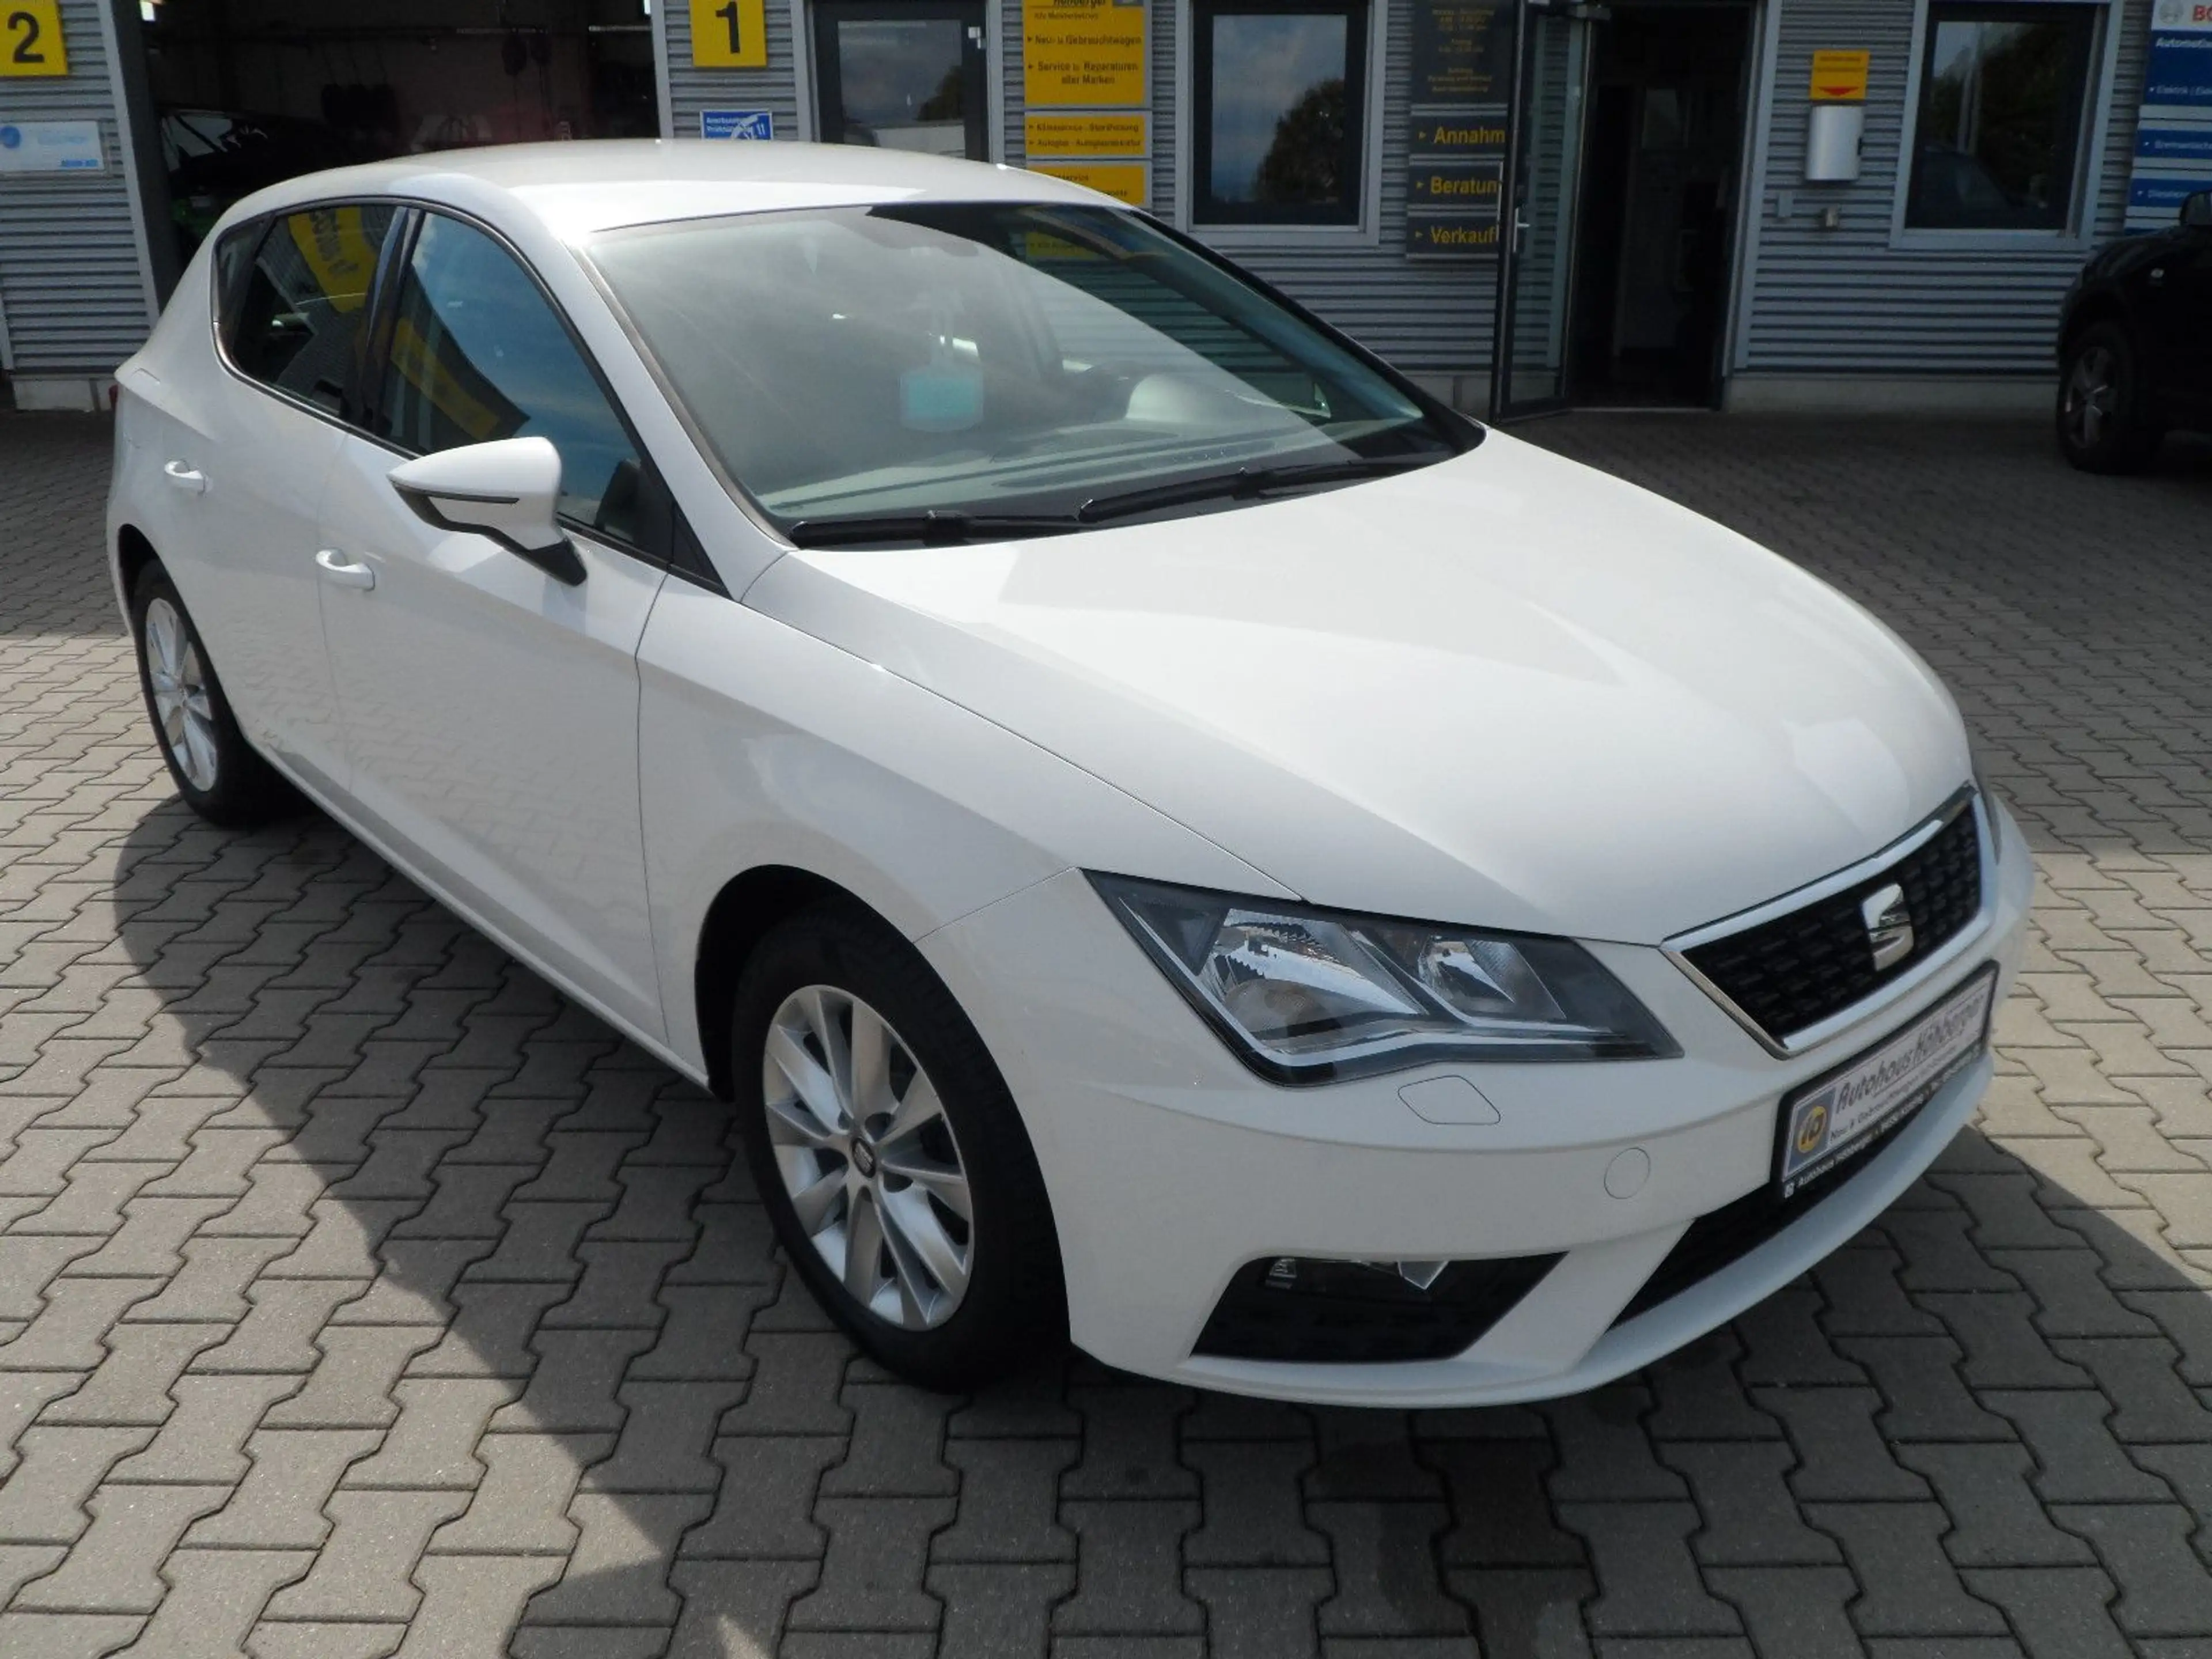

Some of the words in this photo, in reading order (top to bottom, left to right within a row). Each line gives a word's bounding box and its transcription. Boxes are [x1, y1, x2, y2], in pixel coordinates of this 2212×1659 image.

[7, 11, 45, 63] 2
[715, 1, 740, 55] 1
[1434, 126, 1506, 143] Annahm
[1430, 176, 1498, 194] Beratun
[1430, 225, 1497, 244] Verkauf
